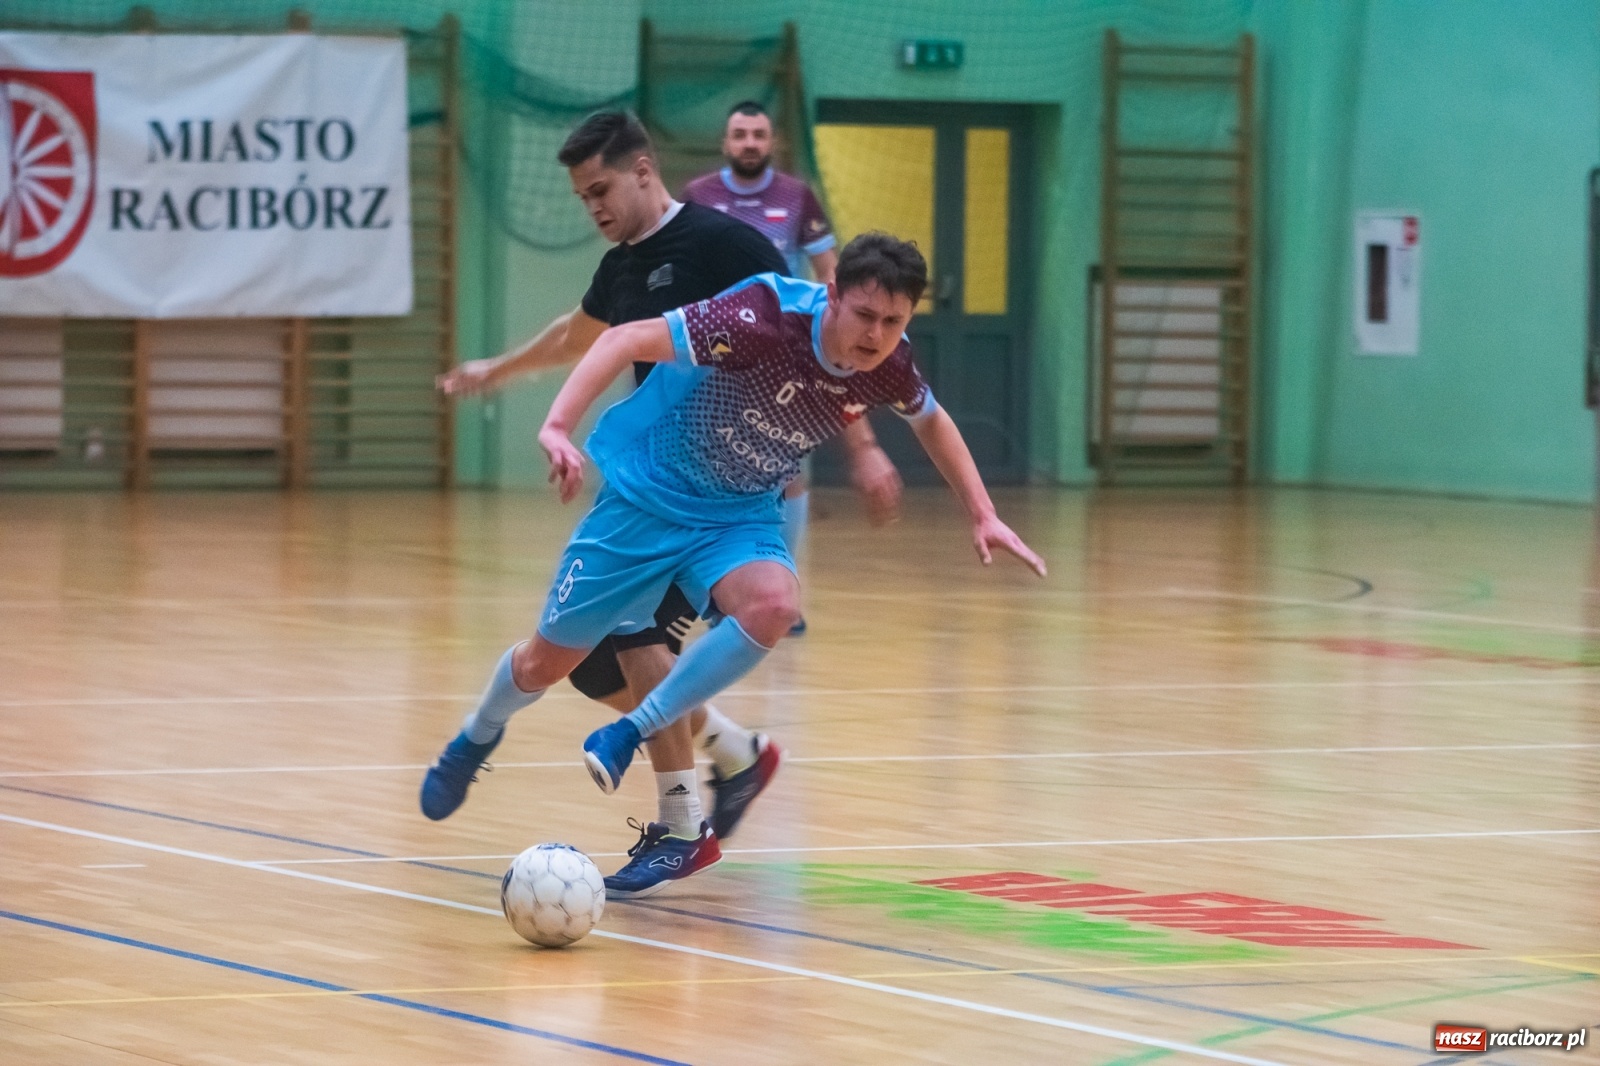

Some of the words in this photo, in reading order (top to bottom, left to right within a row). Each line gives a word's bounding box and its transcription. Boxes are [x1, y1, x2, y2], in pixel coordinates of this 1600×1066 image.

[148, 119, 355, 163] MIASTO
[109, 174, 392, 231] RACIBÓRZ
[776, 380, 804, 405] 6
[557, 557, 584, 604] 6
